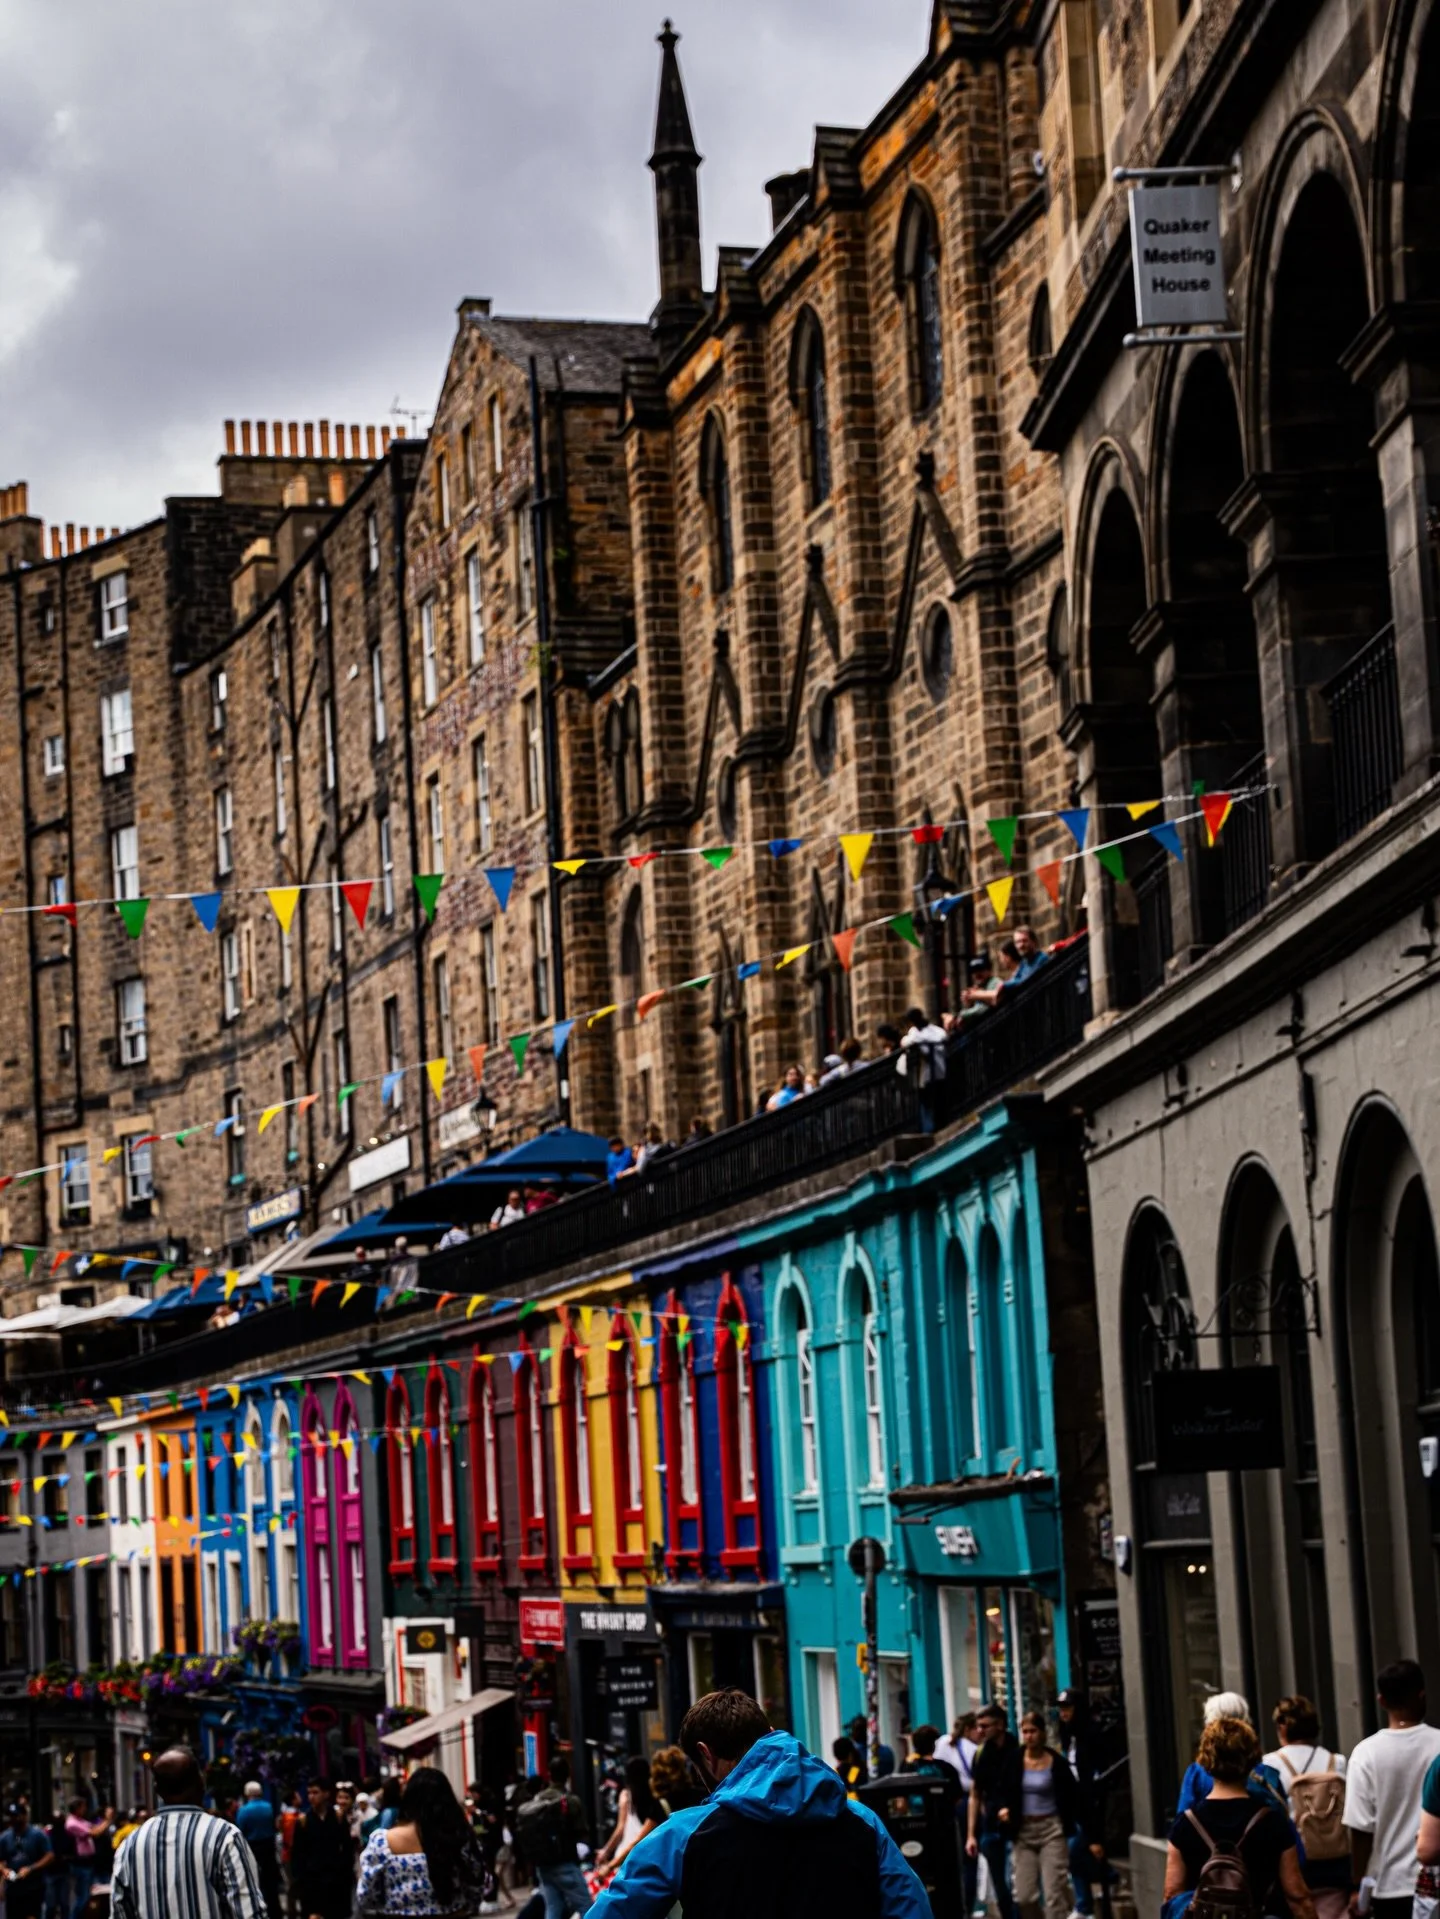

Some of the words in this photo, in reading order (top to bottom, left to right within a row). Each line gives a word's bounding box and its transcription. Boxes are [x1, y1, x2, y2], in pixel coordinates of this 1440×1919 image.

[1144, 218, 1210, 235] Quaker
[1144, 247, 1216, 265] Meeting
[1152, 277, 1211, 293] House
[580, 1611, 596, 1630] THE
[625, 1611, 647, 1631] SHOP
[620, 1666, 642, 1676] THE
[609, 1680, 654, 1692] WHISKY
[617, 1695, 648, 1707] SHOP
